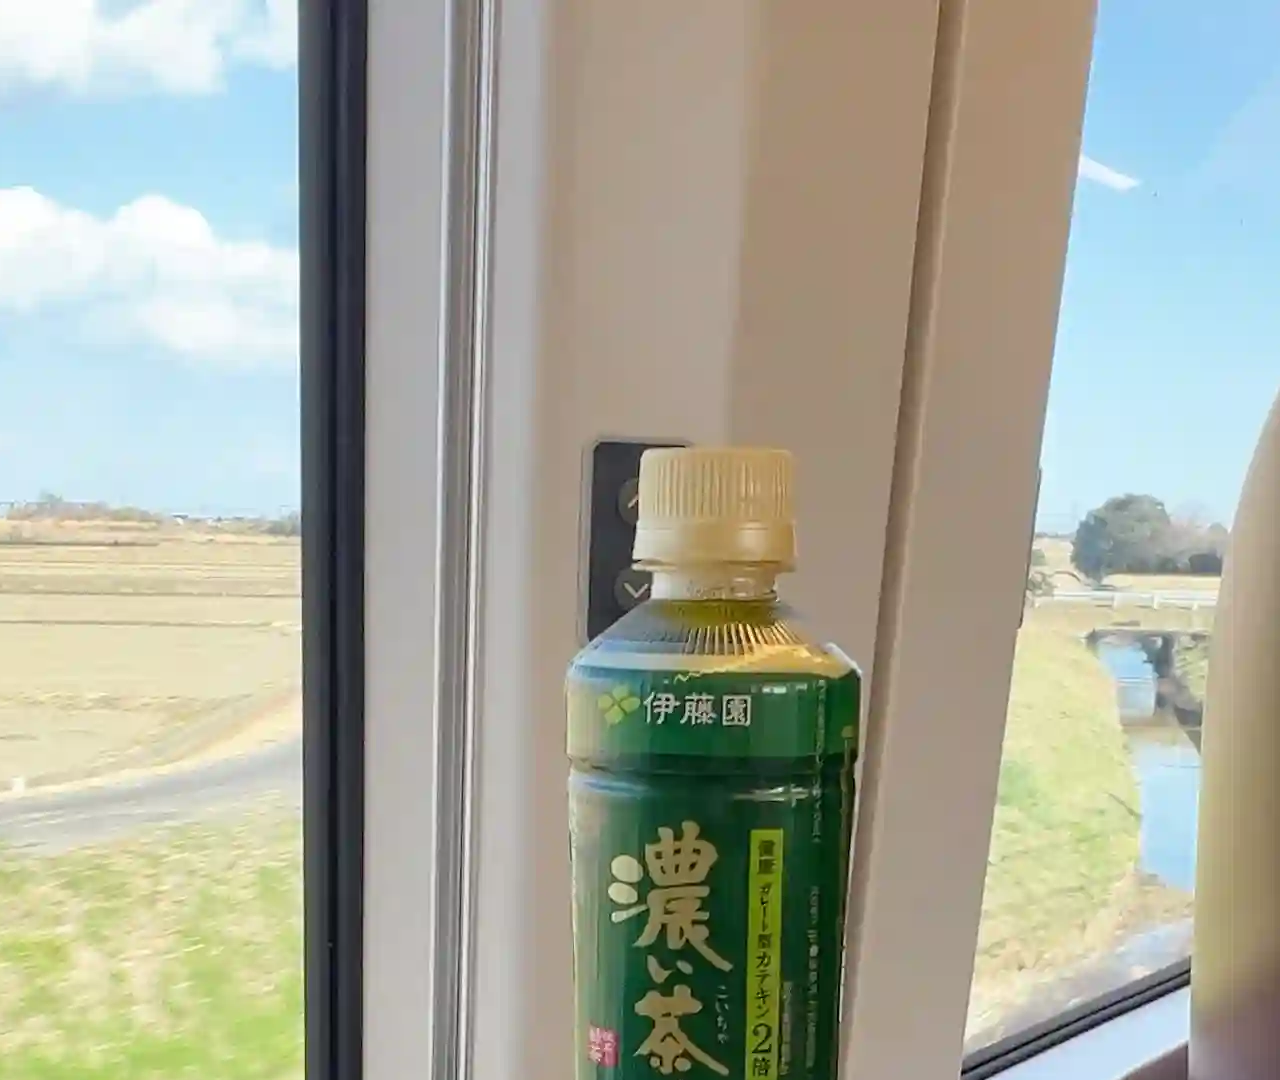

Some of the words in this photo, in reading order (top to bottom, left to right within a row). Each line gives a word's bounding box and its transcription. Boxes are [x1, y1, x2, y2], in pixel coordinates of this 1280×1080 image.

[643, 691, 752, 727] 伊藤園
[607, 820, 733, 1076] 濃い茶
